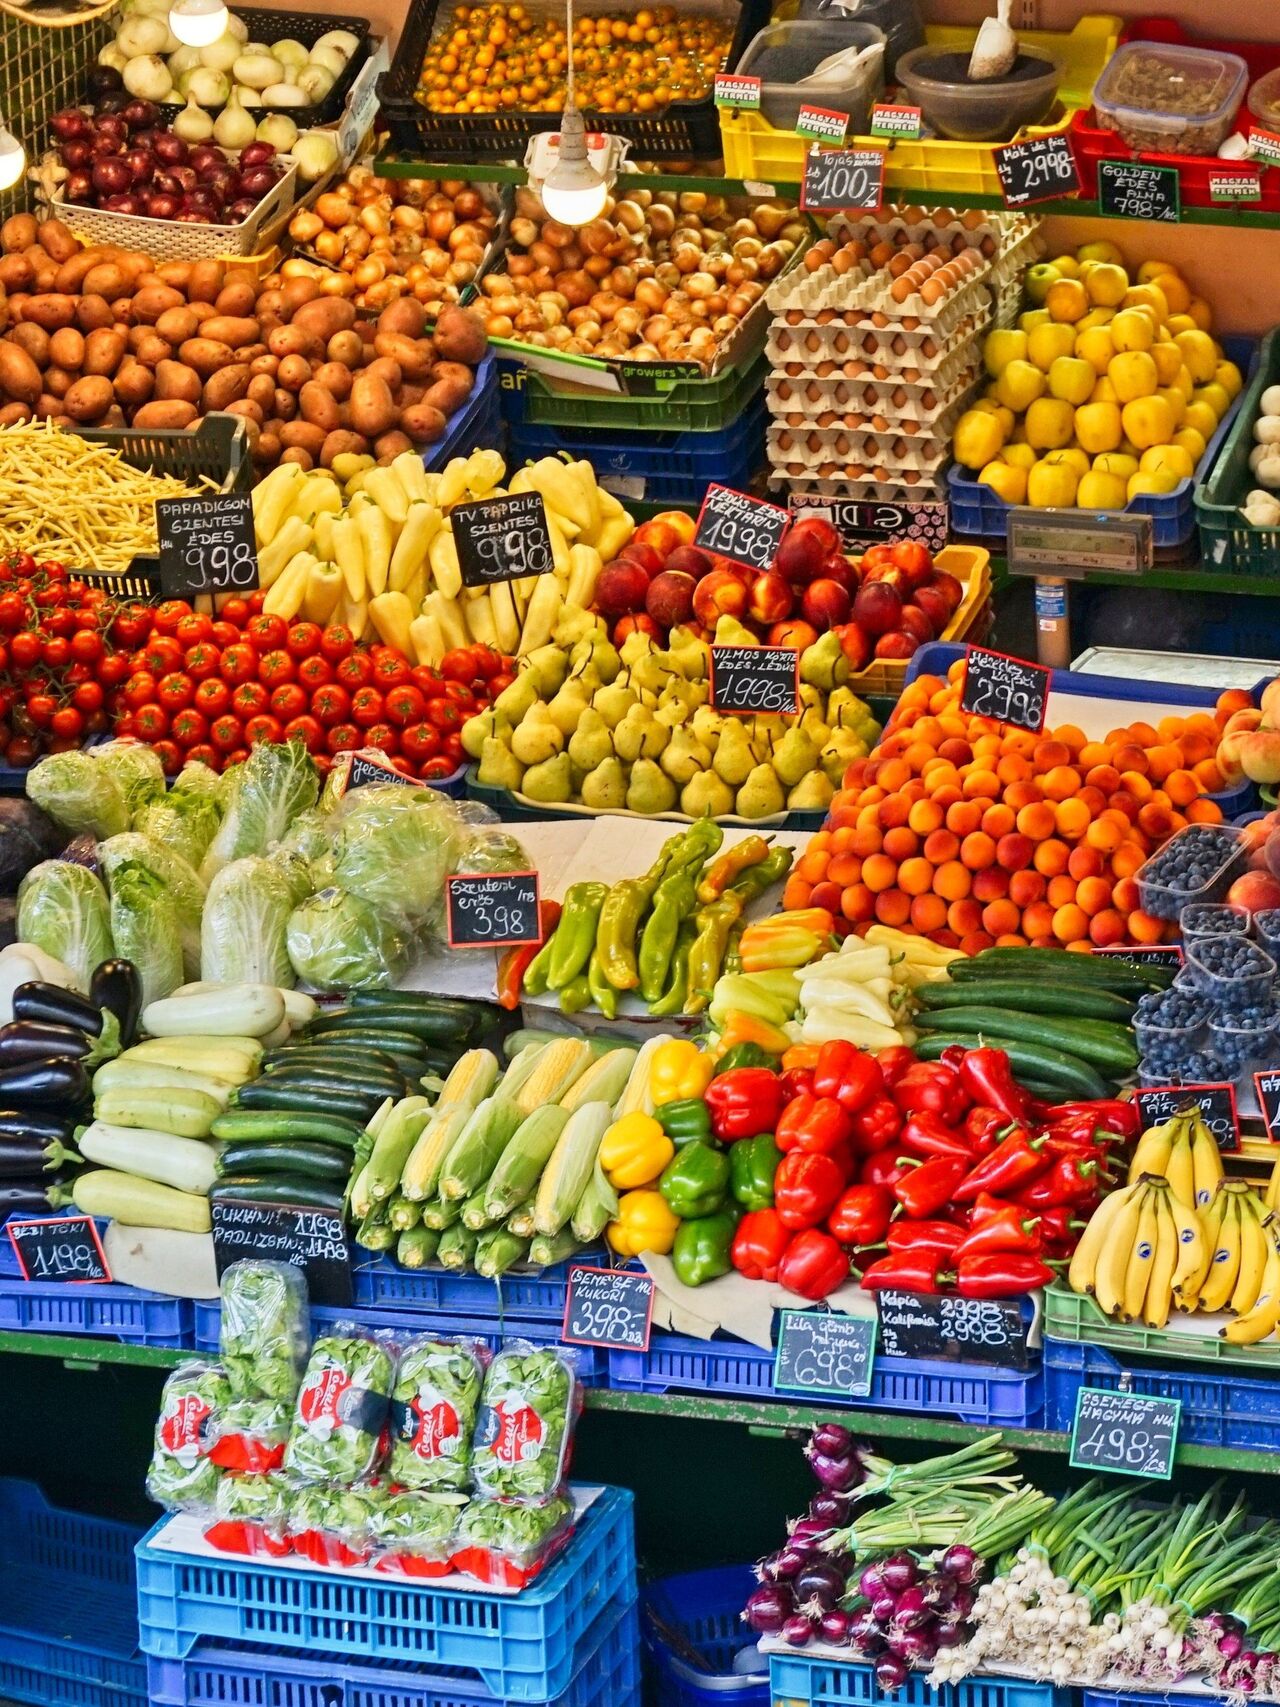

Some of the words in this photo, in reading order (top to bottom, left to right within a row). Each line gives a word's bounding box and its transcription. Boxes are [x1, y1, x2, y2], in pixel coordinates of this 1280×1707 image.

[717, 80, 757, 90] MAGYAR
[718, 91, 756, 101] TERMÉK
[801, 111, 844, 127] MAGYAR
[876, 110, 917, 119] MAGYAR
[801, 121, 841, 136] TERMÉK
[875, 120, 915, 130] TERMÉK
[1102, 165, 1162, 181] GOLDEN
[1212, 177, 1257, 185] MAGYAR
[1126, 189, 1166, 203] ALMA
[1215, 186, 1256, 195] TERMÉK
[623, 367, 676, 379] growers
[455, 510, 477, 523] TV
[481, 497, 543, 517] PAPRIKA
[706, 500, 778, 530] NEKTARIN
[712, 649, 760, 661] VILMOS
[473, 906, 525, 937] 398
[795, 1347, 855, 1388] 698
[1081, 1393, 1159, 1412] CSEMEGE
[1080, 1406, 1145, 1424] HAGYMA
